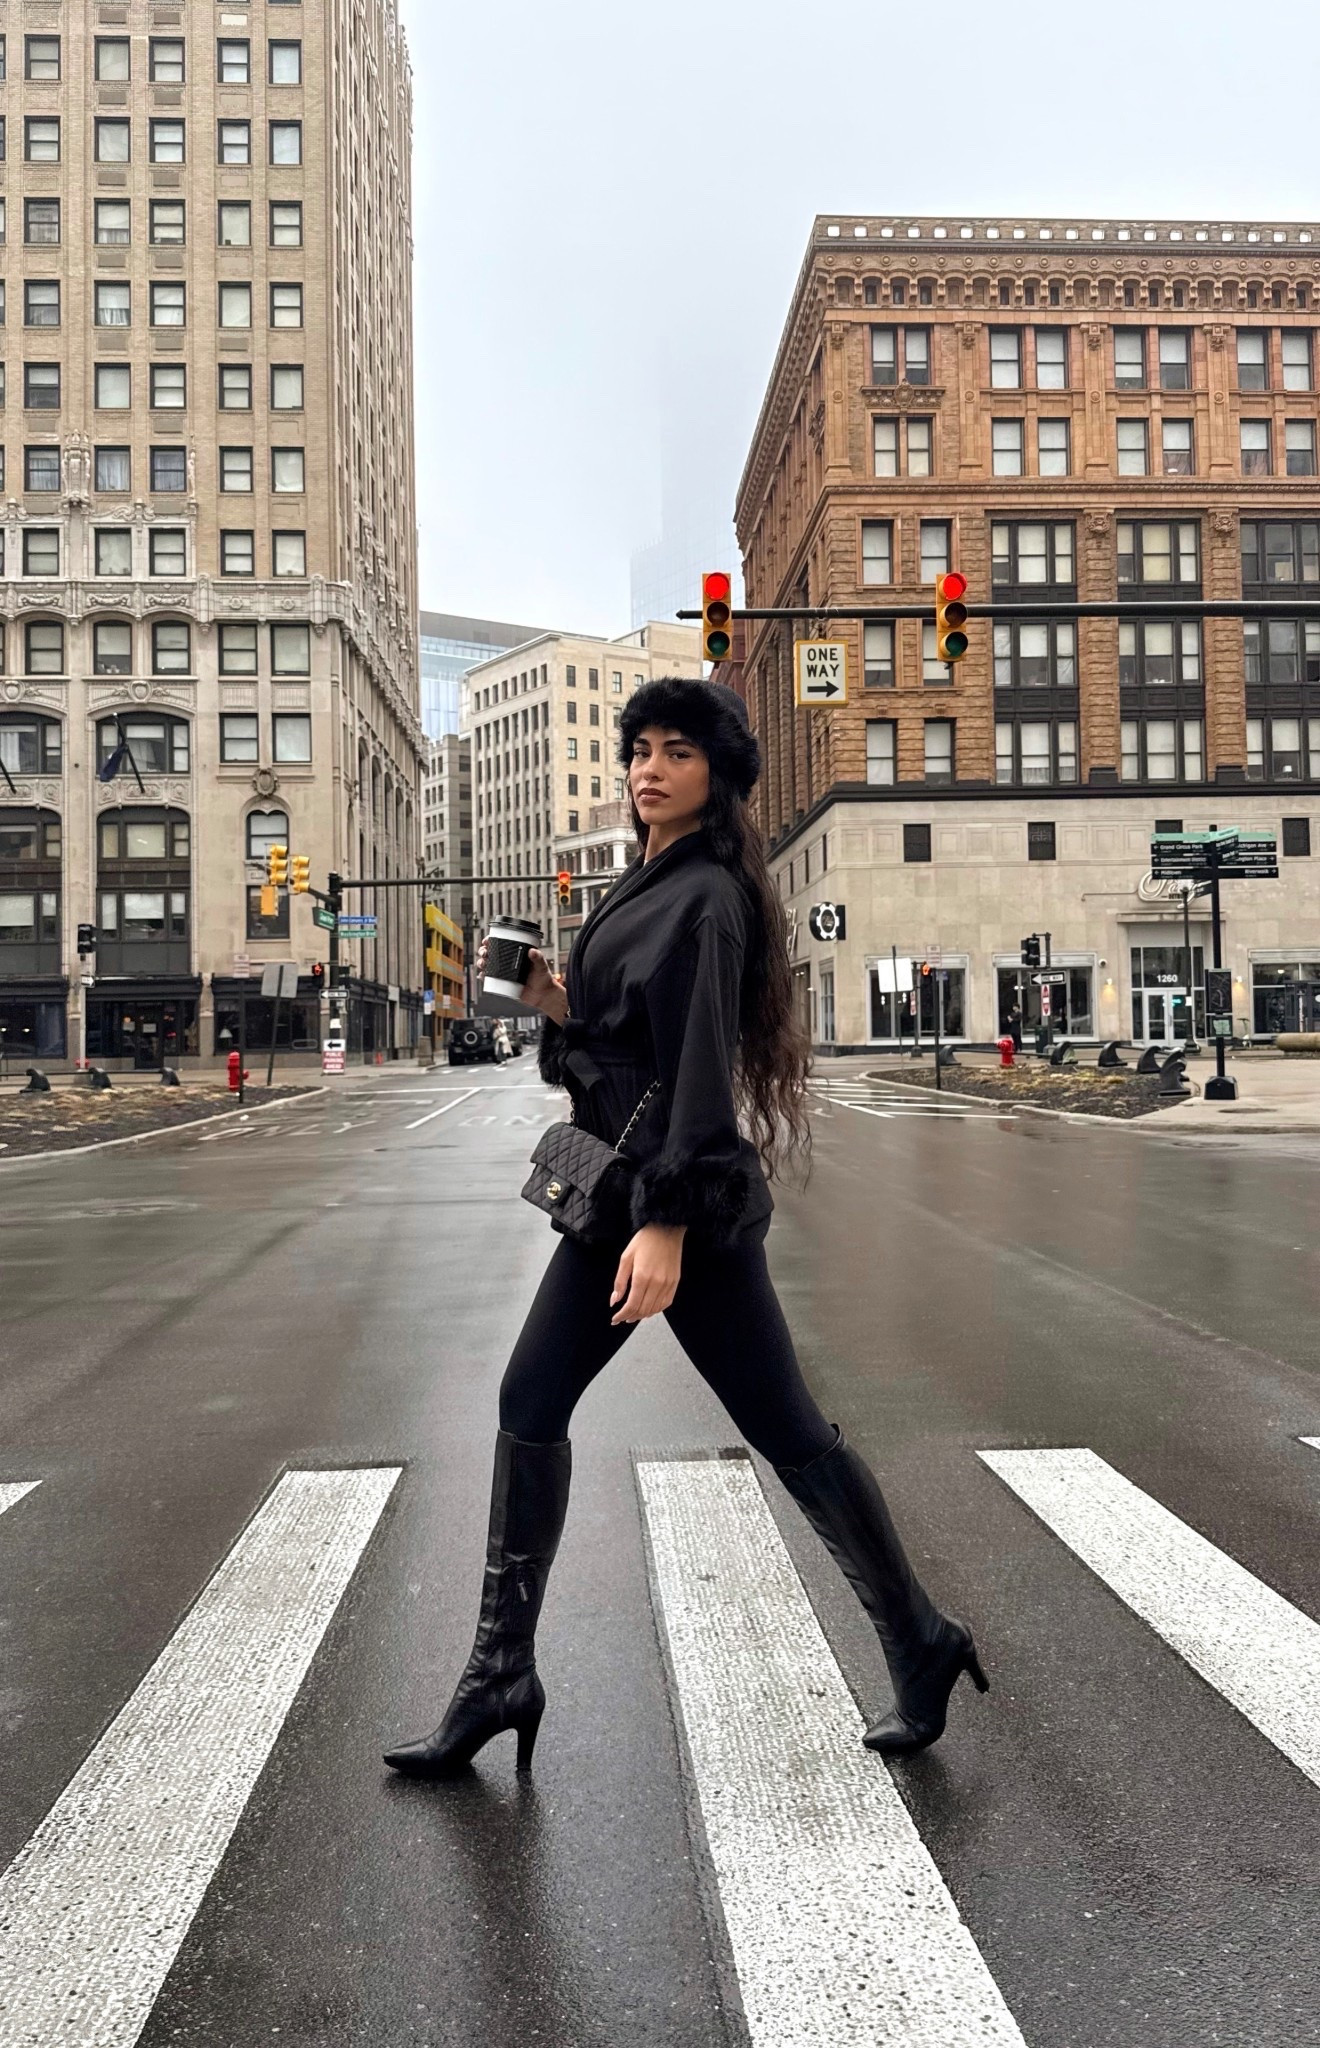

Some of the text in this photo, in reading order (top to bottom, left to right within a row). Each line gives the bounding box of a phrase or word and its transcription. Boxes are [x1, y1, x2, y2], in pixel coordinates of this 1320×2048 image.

[807, 648, 838, 661] ONE
[806, 664, 840, 678] WAY
[1157, 974, 1178, 983] 1260
